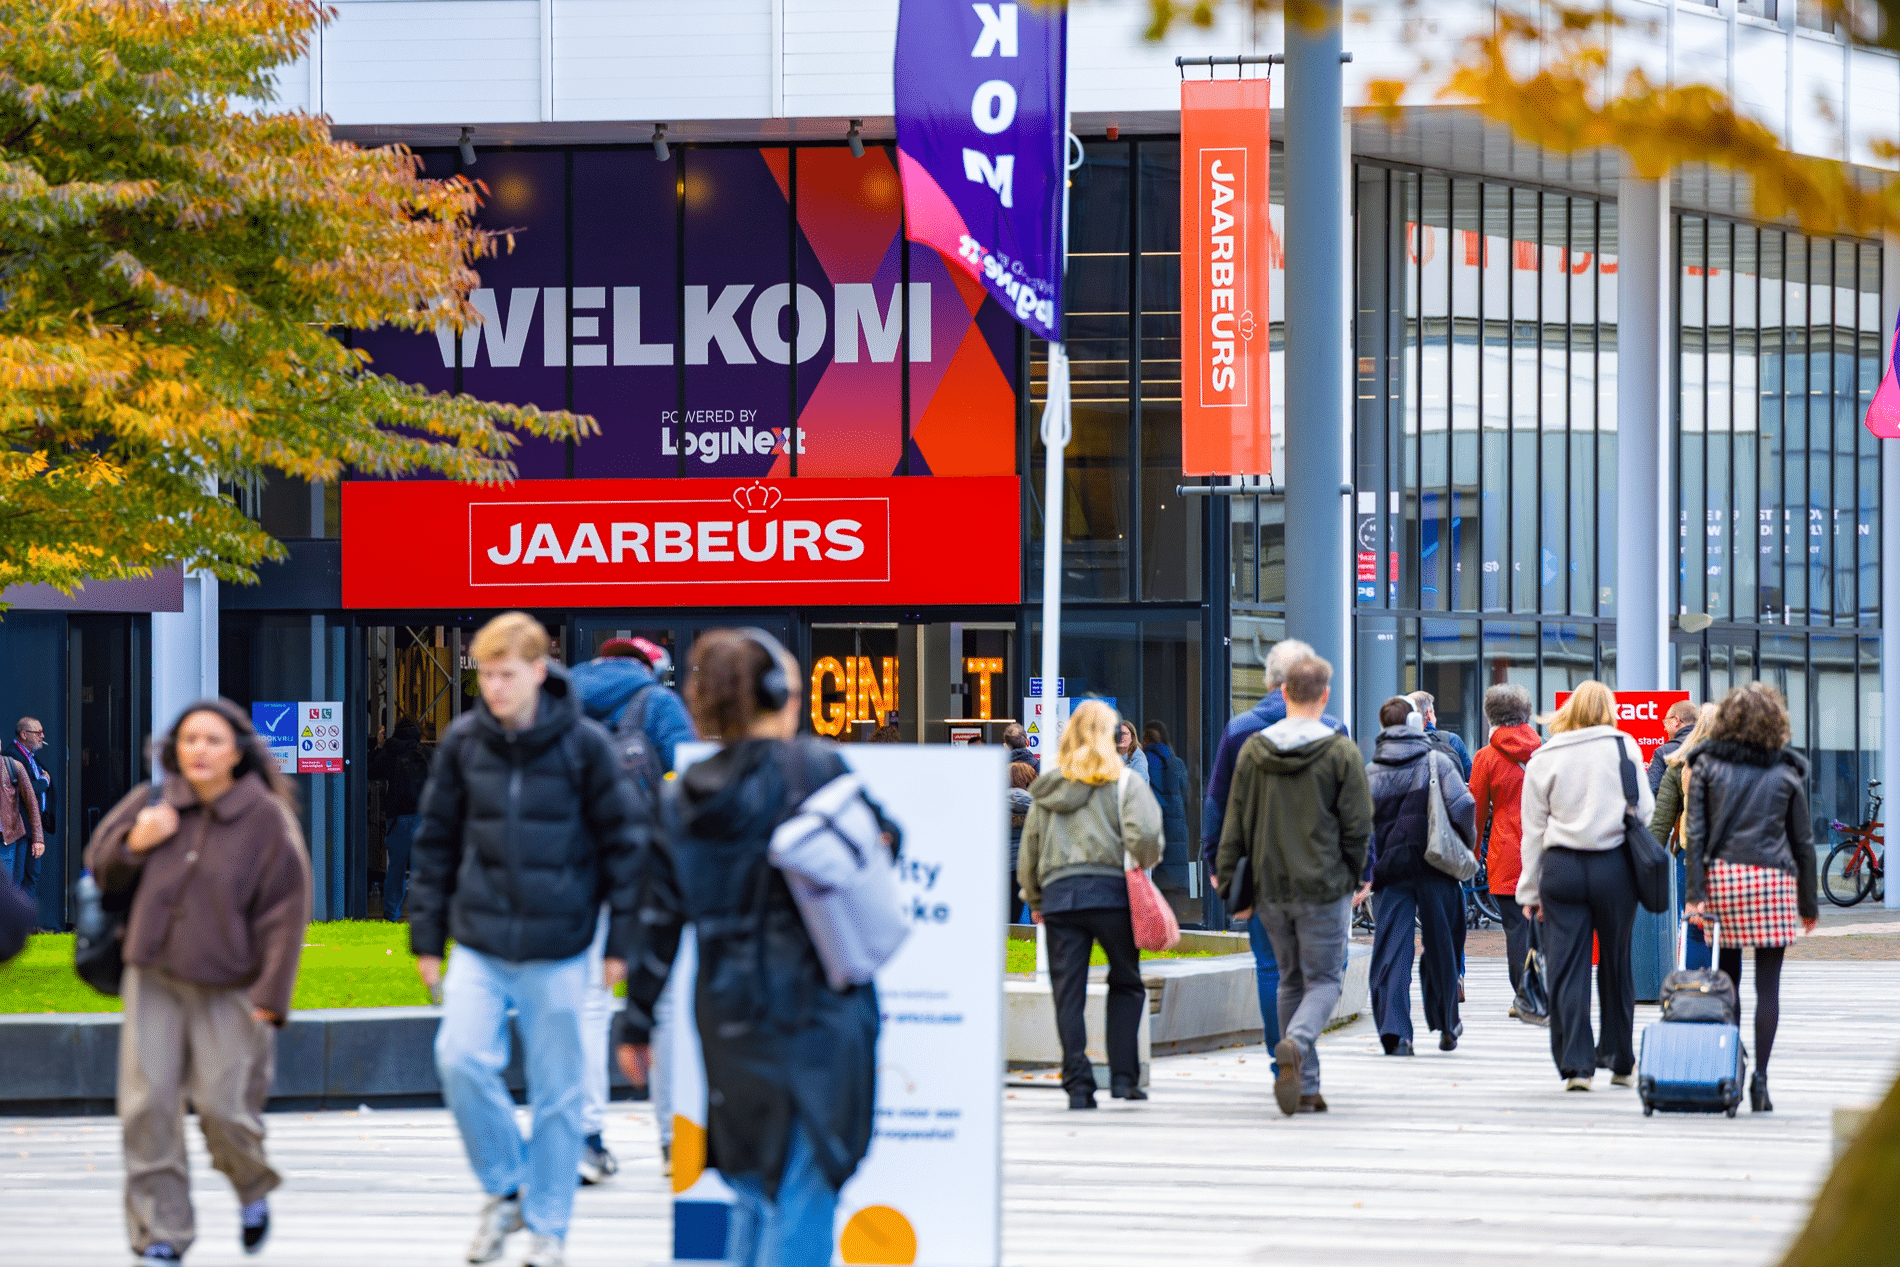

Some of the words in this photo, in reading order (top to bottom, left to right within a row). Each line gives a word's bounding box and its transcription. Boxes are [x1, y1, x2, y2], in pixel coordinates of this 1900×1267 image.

[1210, 159, 1236, 392] JAARBEURS
[427, 282, 932, 369] WELKOM
[739, 409, 758, 423] BY
[661, 426, 806, 464] LogiNext
[487, 518, 865, 565] JAARBEURS
[1615, 701, 1659, 720] xact
[1637, 736, 1665, 746] stand
